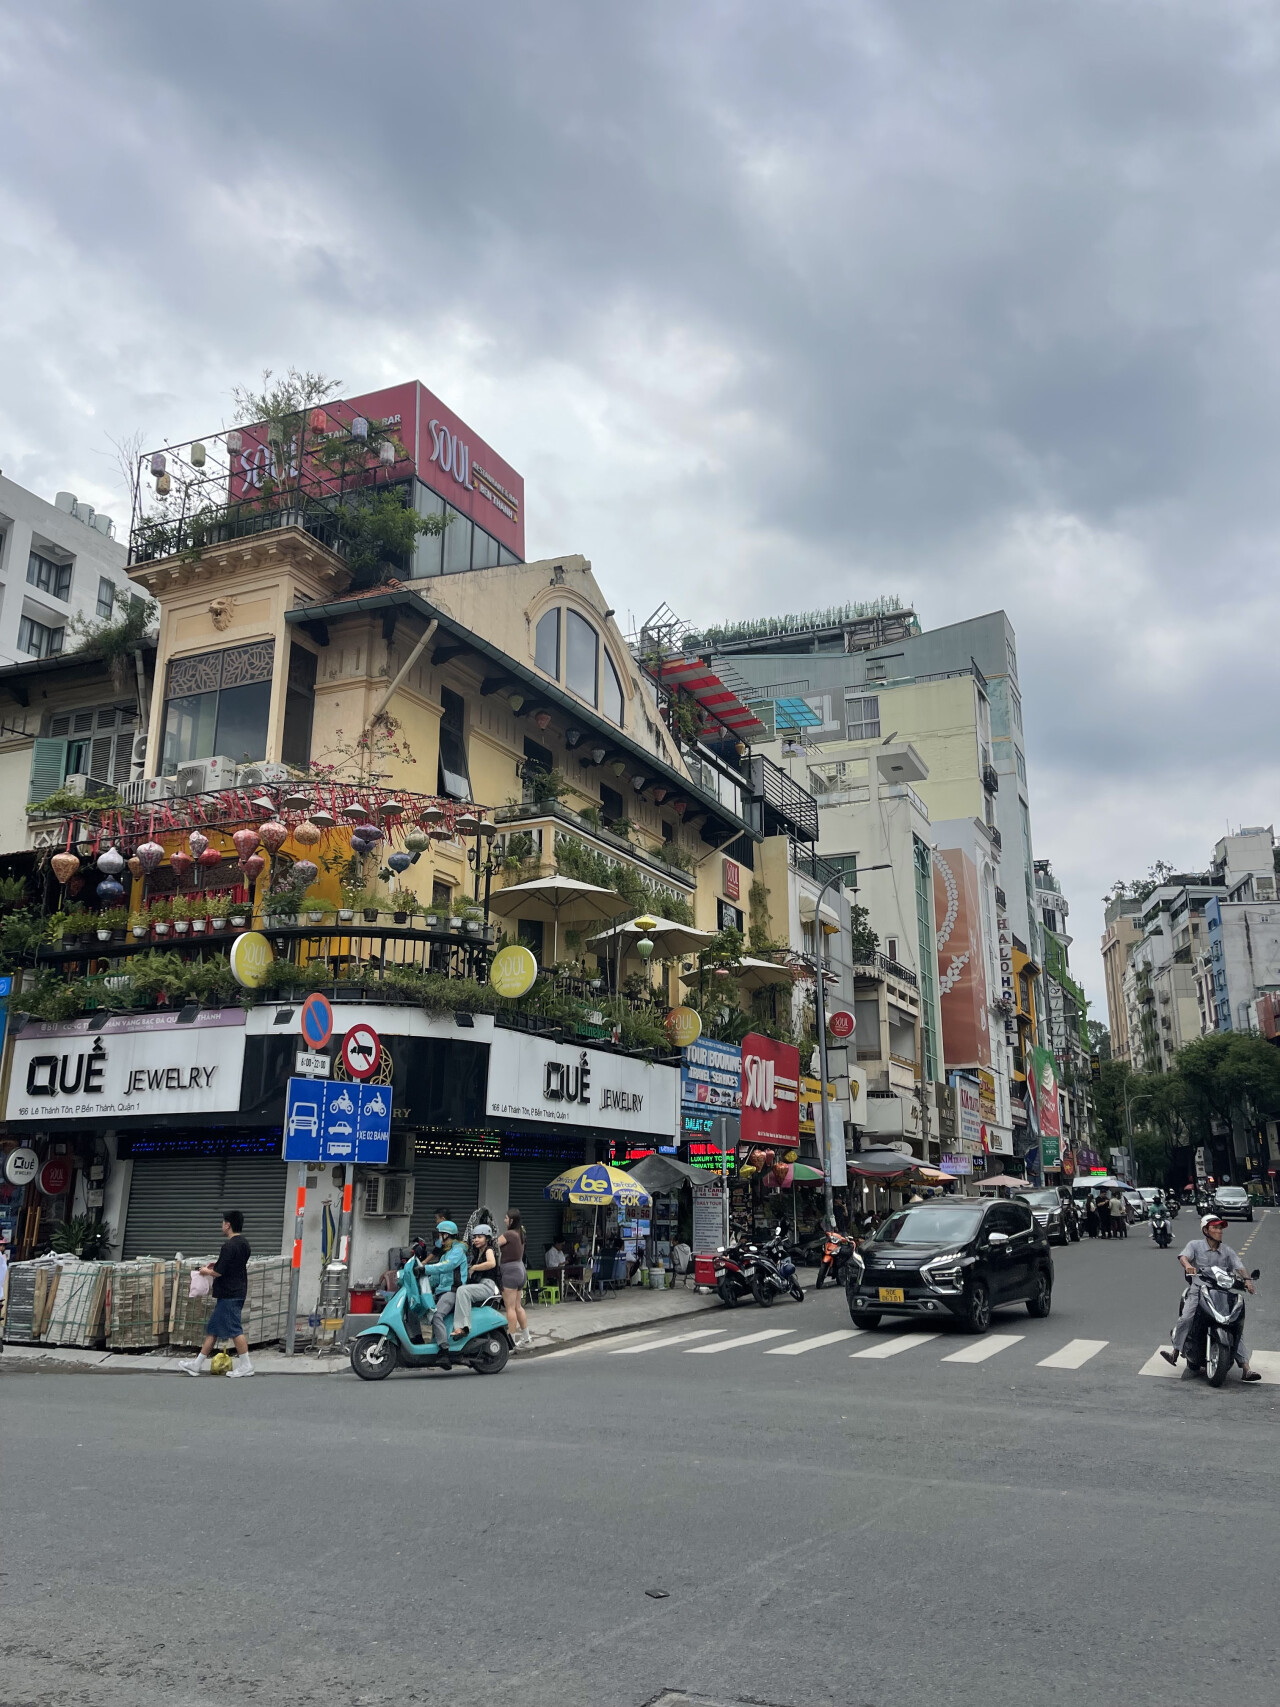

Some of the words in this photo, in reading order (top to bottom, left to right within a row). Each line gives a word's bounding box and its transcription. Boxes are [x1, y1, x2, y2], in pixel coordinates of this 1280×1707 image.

[428, 419, 474, 491] SOUL
[244, 942, 266, 967] SOUL
[499, 955, 526, 979] SOUL
[670, 1014, 693, 1031] SOUL
[835, 1017, 848, 1027] SOUL
[1001, 976, 1015, 1046] HOEL
[26, 1035, 108, 1097] QUẾ
[686, 1045, 707, 1066] TOUR
[707, 1050, 742, 1073] BOOKING
[124, 1066, 219, 1096] JEWELRY
[543, 1050, 591, 1104] QUẾ
[688, 1066, 711, 1082] TRAVEL
[711, 1071, 739, 1087] SERVICES
[745, 1054, 777, 1112] SOUL
[599, 1088, 644, 1112] JEWELRY
[359, 1130, 366, 1140] XE
[549, 1188, 565, 1202] 50K
[580, 1174, 608, 1193] be
[593, 1195, 603, 1203] XE
[619, 1195, 640, 1207] 50K
[626, 1207, 636, 1218] 4G
[640, 1208, 650, 1218] 5G
